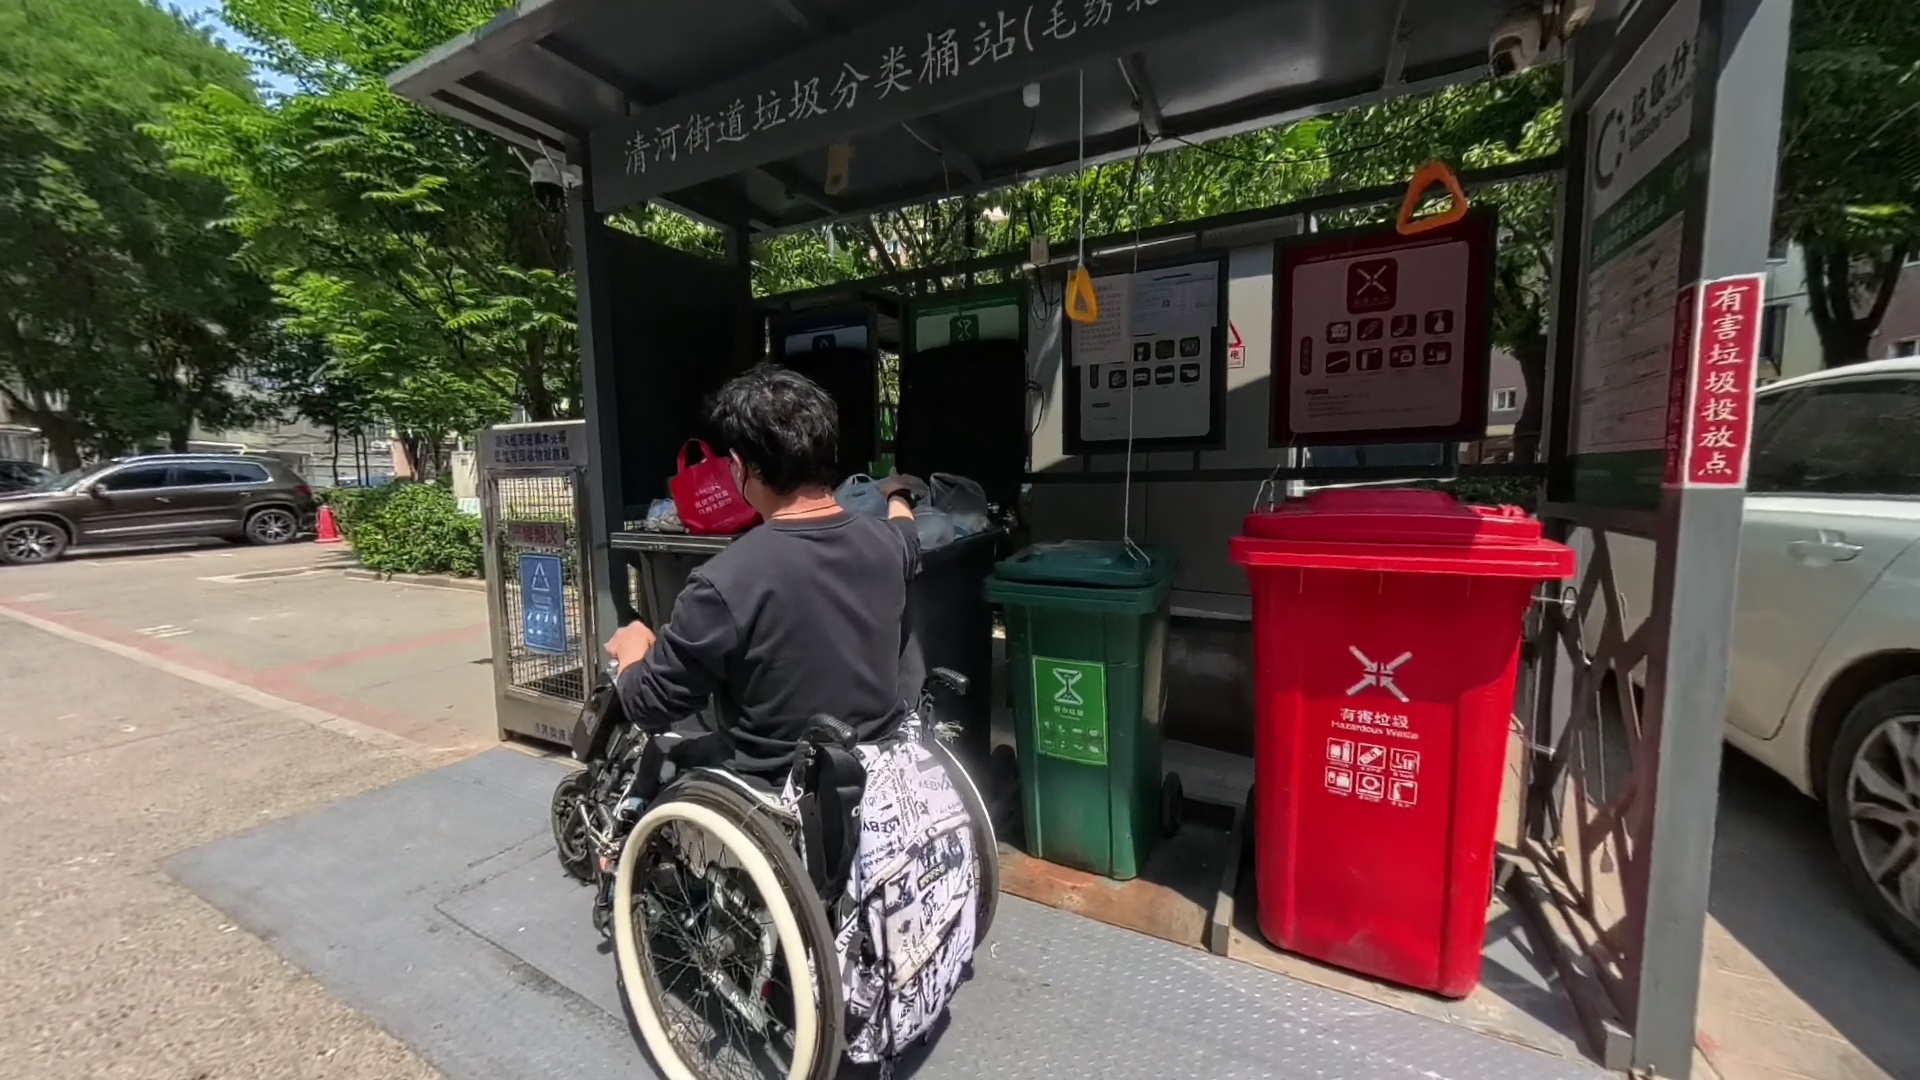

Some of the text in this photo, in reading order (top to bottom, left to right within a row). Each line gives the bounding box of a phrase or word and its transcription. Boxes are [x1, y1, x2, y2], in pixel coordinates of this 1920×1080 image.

[624, 0, 1160, 175] 清河街道垃圾分类桶站(毛纺
[1698, 284, 1750, 476] 有害垃圾投放点
[1331, 720, 1419, 740] Hazardous Waste
[1340, 708, 1409, 729] 有害垃圾
